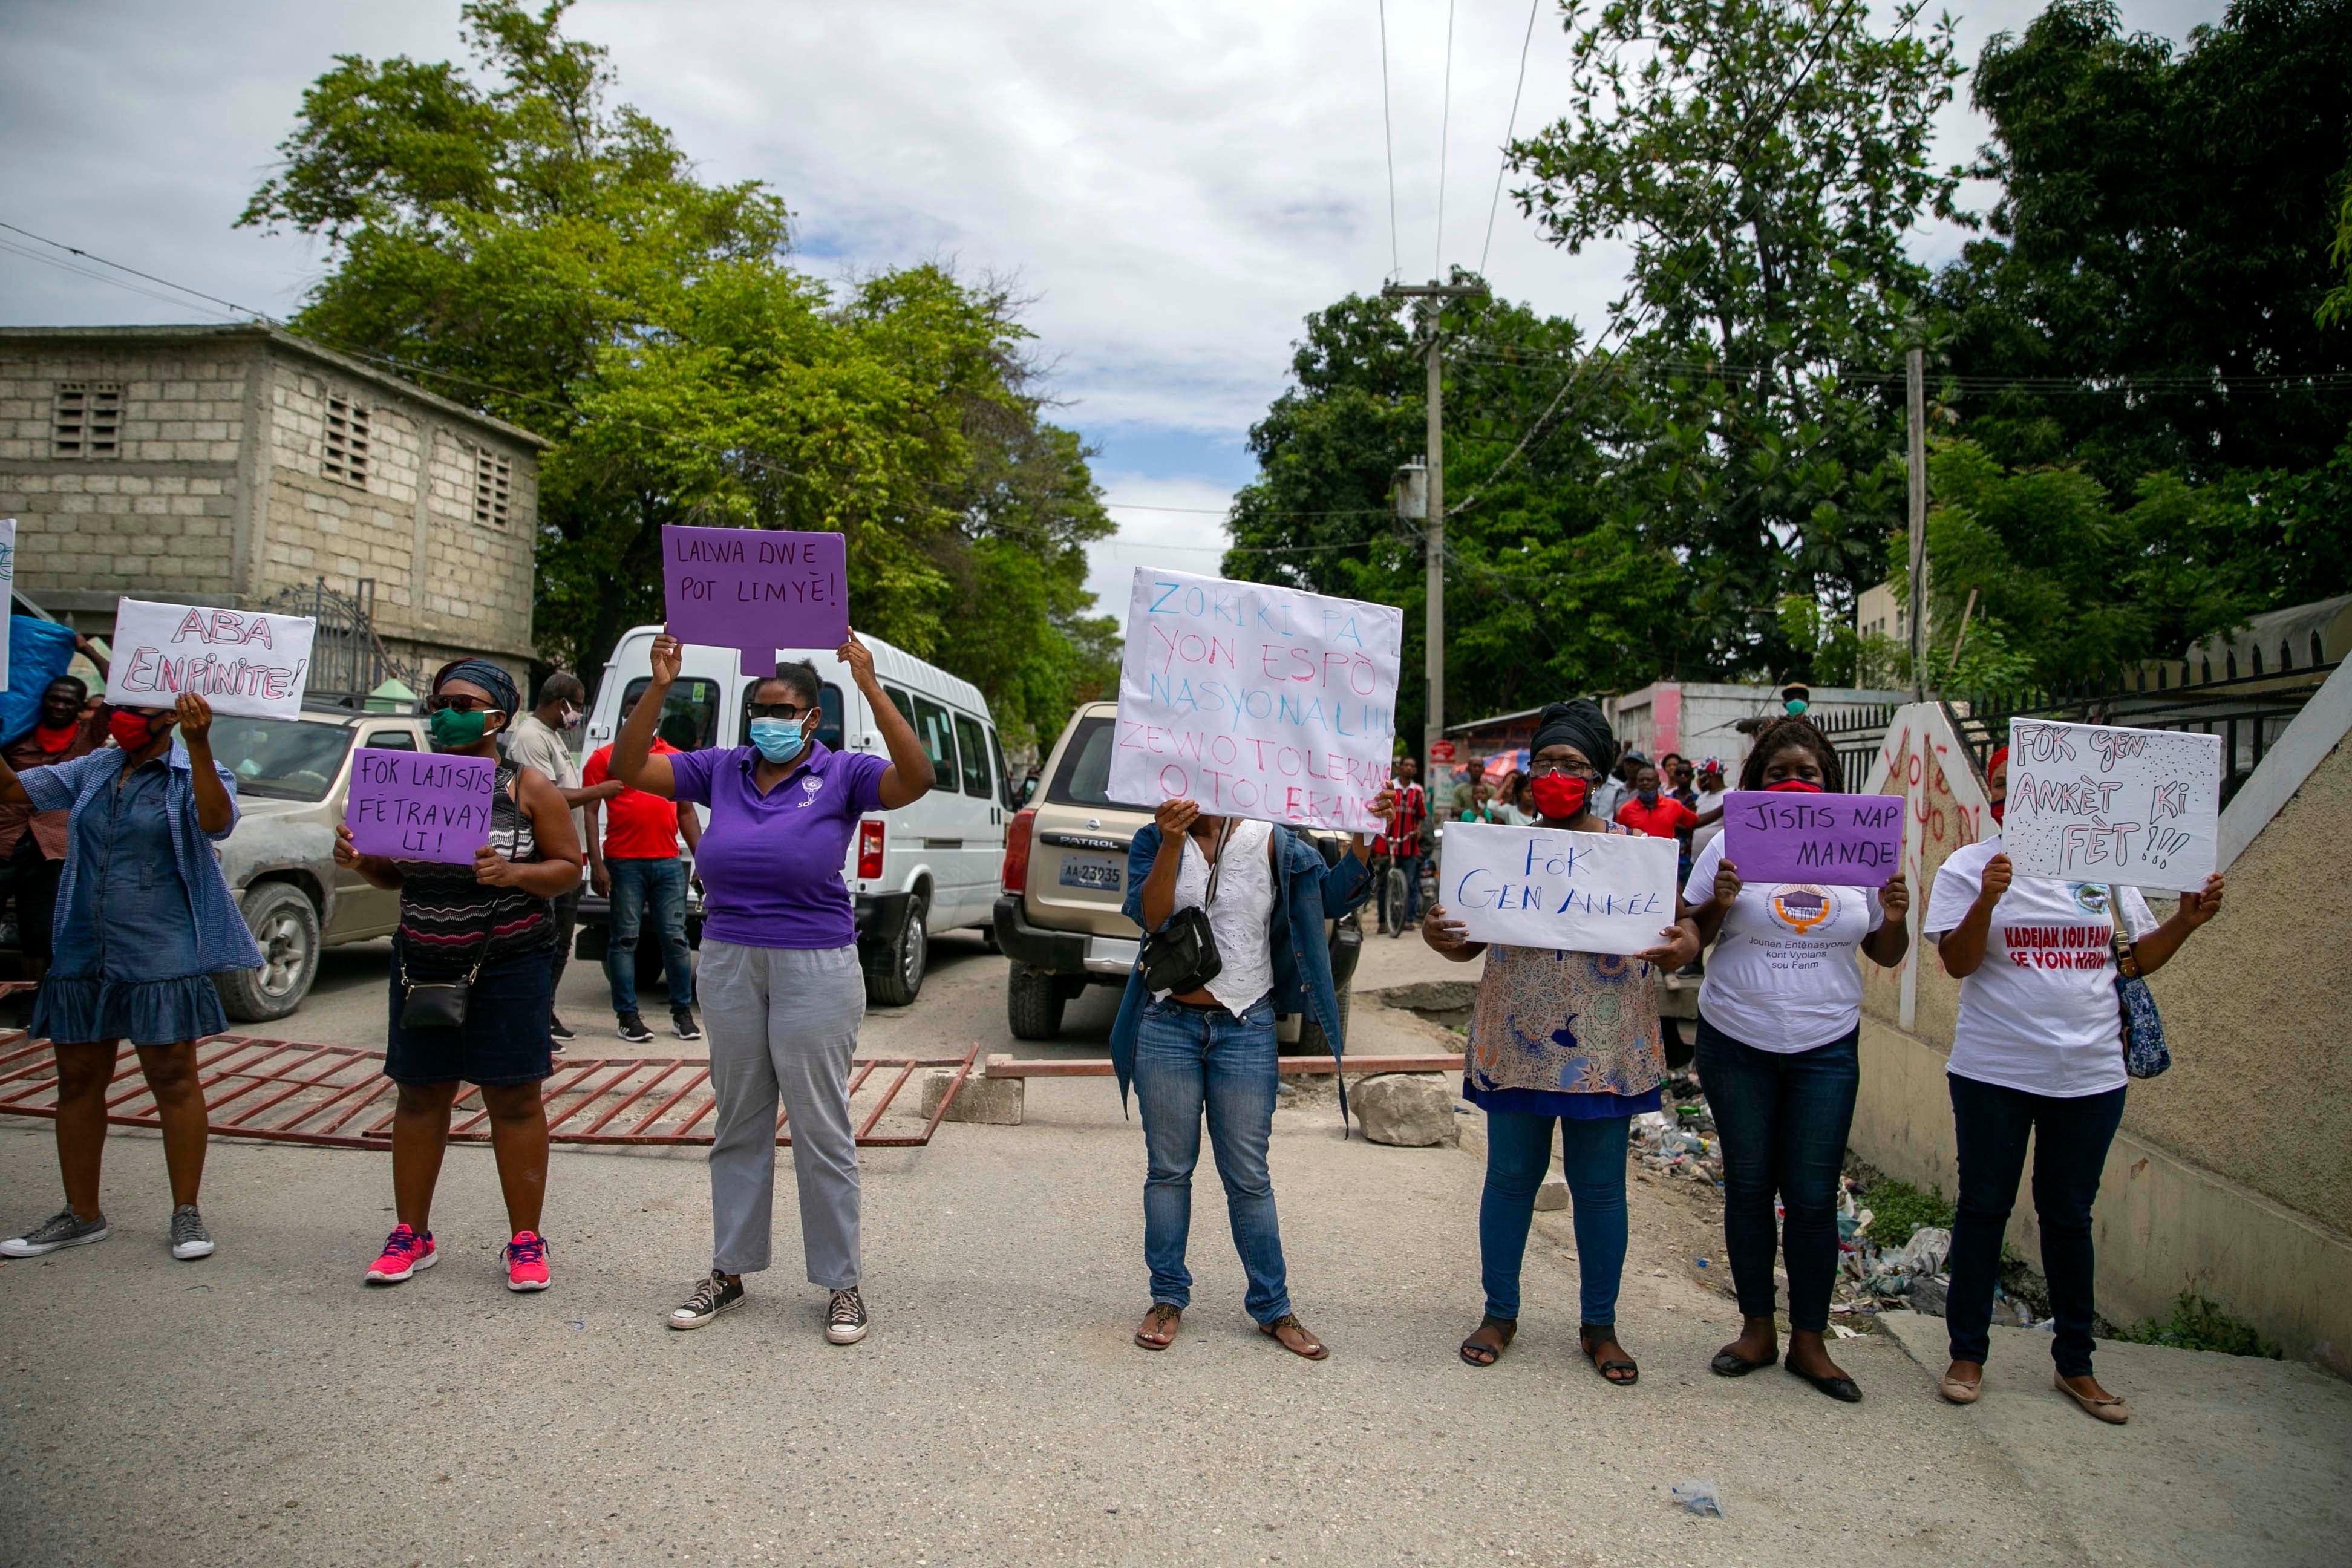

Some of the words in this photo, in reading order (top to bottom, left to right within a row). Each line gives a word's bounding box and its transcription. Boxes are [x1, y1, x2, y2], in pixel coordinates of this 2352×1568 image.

[677, 538, 745, 563] LALWA
[681, 577, 716, 601] POT
[1149, 582, 1293, 637] ZOKIKI
[1322, 610, 1362, 648] PA
[171, 608, 272, 650] ABA
[1153, 625, 1235, 674] YON
[413, 762, 492, 794] LAJISTIS
[394, 798, 488, 834] TRAVAY
[1745, 801, 1835, 831] JISTIS
[1853, 806, 1898, 828] NAP
[1060, 836, 1119, 848] PATROL
[1797, 841, 1897, 867] MANDE!
[1458, 869, 1542, 910] GEN
[1749, 937, 1782, 948] Jounen
[2004, 927, 2059, 952] KADEJAK
[2062, 926, 2085, 949] SOU
[1766, 950, 1786, 959] kont
[1789, 950, 1827, 961] Vyolans
[1792, 961, 1819, 969] Fanm
[2032, 951, 2073, 969] YON
